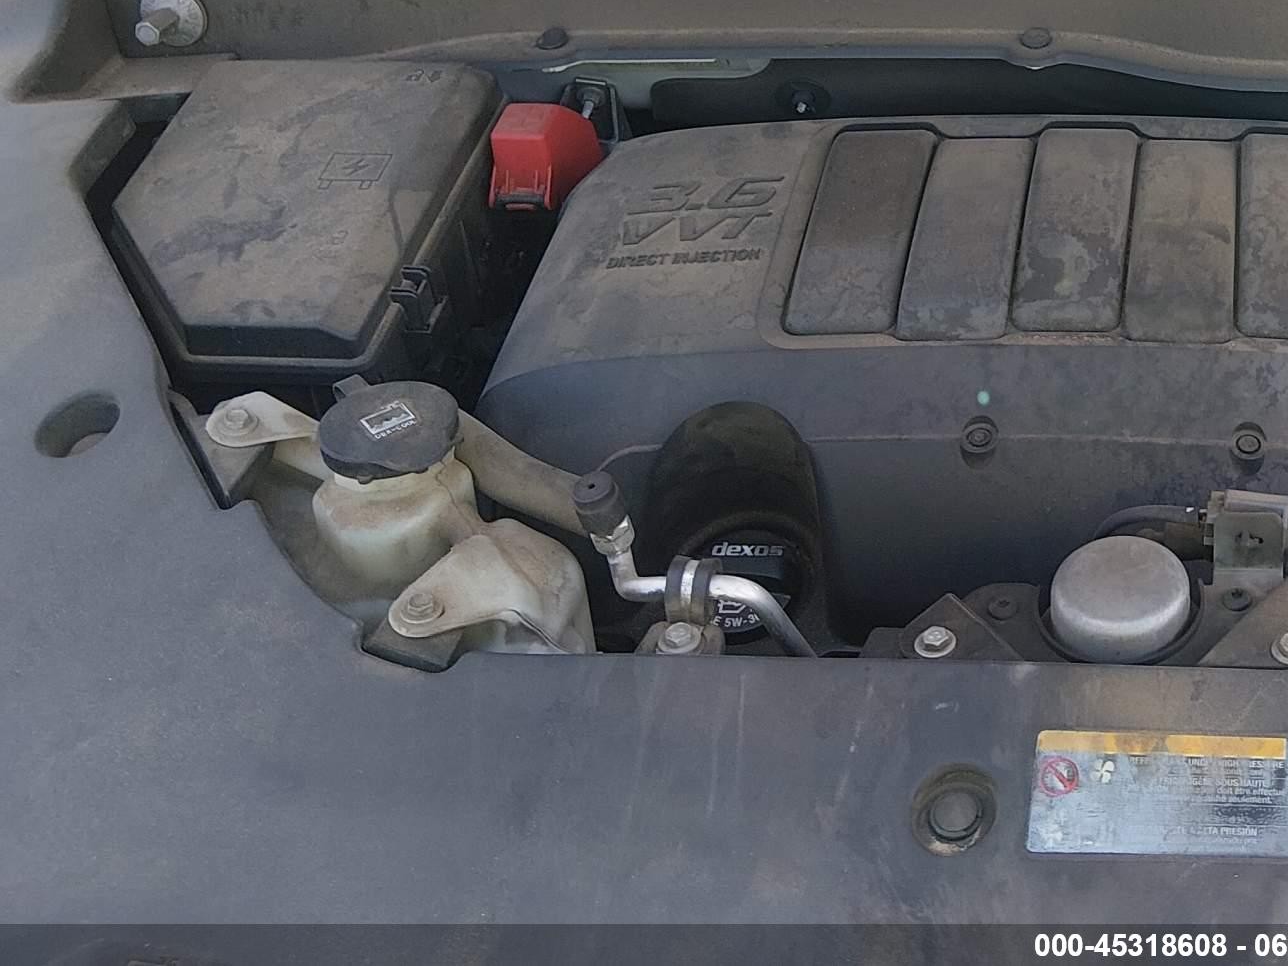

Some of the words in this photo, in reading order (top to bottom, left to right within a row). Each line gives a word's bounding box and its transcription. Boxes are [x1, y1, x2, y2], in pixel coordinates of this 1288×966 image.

[626, 176, 785, 216] 3.6
[622, 212, 774, 246] VVT
[606, 252, 670, 269] DIRECT
[671, 248, 761, 265] INJECTION
[711, 542, 784, 557] dexos
